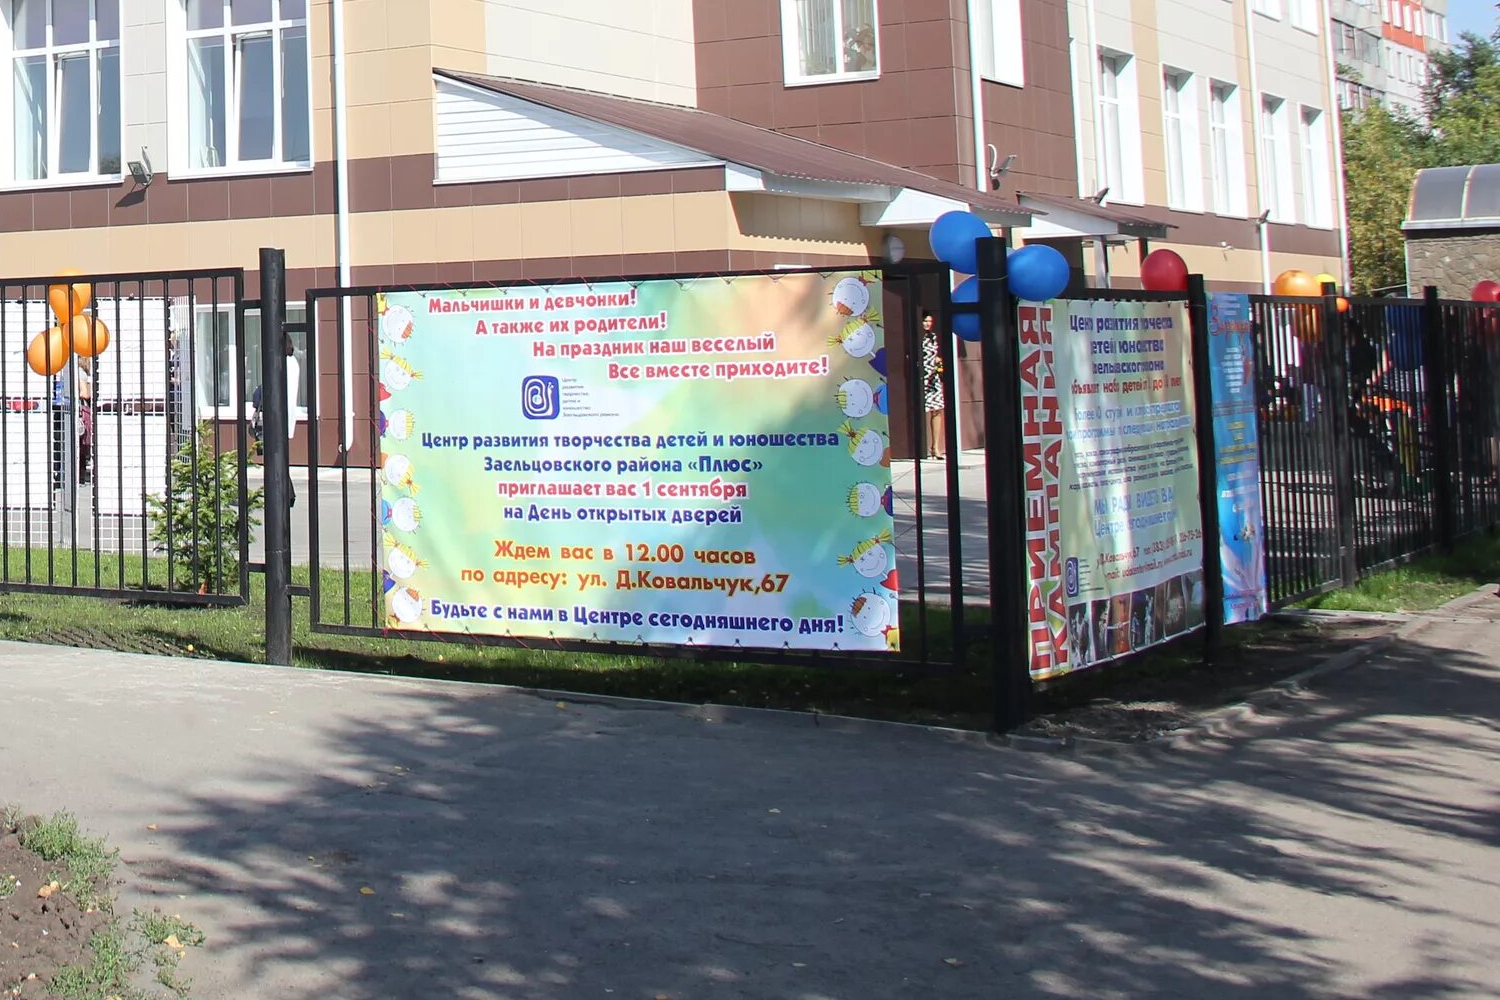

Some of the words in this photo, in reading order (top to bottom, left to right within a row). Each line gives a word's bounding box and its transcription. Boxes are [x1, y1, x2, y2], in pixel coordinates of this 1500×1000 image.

[429, 298, 524, 313] Мальчишки
[530, 298, 539, 310] и
[545, 289, 637, 311] девчонки!
[476, 320, 487, 335] А
[492, 321, 544, 334] также
[550, 320, 569, 333] их
[574, 312, 666, 334] родители!
[533, 341, 556, 357] На
[561, 341, 644, 358] праздник
[649, 340, 686, 354] наш
[692, 333, 774, 352] веселый
[609, 363, 640, 379] Все
[645, 363, 710, 378] вместе
[716, 356, 828, 380] приходите!
[421, 432, 469, 450] Центр
[473, 436, 549, 450] развития
[554, 435, 650, 450] творчества
[656, 431, 708, 449] детей
[713, 435, 724, 447] и
[729, 433, 839, 447] юношества
[484, 456, 612, 474] Заельцовского
[617, 457, 682, 475] района
[498, 482, 601, 498] приглашает
[606, 484, 637, 496] вас
[642, 481, 650, 496] 1
[657, 478, 747, 500] сентября
[1019, 306, 1051, 671] ПРИЕМНАЯ
[1040, 308, 1068, 664] КАМПАНИЯ
[504, 507, 523, 519] на
[528, 504, 571, 521] День
[577, 508, 666, 524] открытых
[672, 505, 742, 526] дверей
[494, 540, 550, 560] Ждем
[561, 546, 594, 560] вас
[603, 548, 614, 560] в
[626, 544, 684, 563] 12.00
[694, 549, 756, 564] часов
[461, 569, 484, 582] по
[493, 572, 567, 590] адресу:
[578, 574, 607, 590] ул.
[431, 600, 487, 619] Будьте
[493, 605, 503, 618] с
[507, 607, 553, 621] нами
[559, 609, 568, 622] в
[574, 606, 643, 628] Центре
[649, 611, 793, 632] сегодняшнего
[799, 615, 844, 634] дня!
